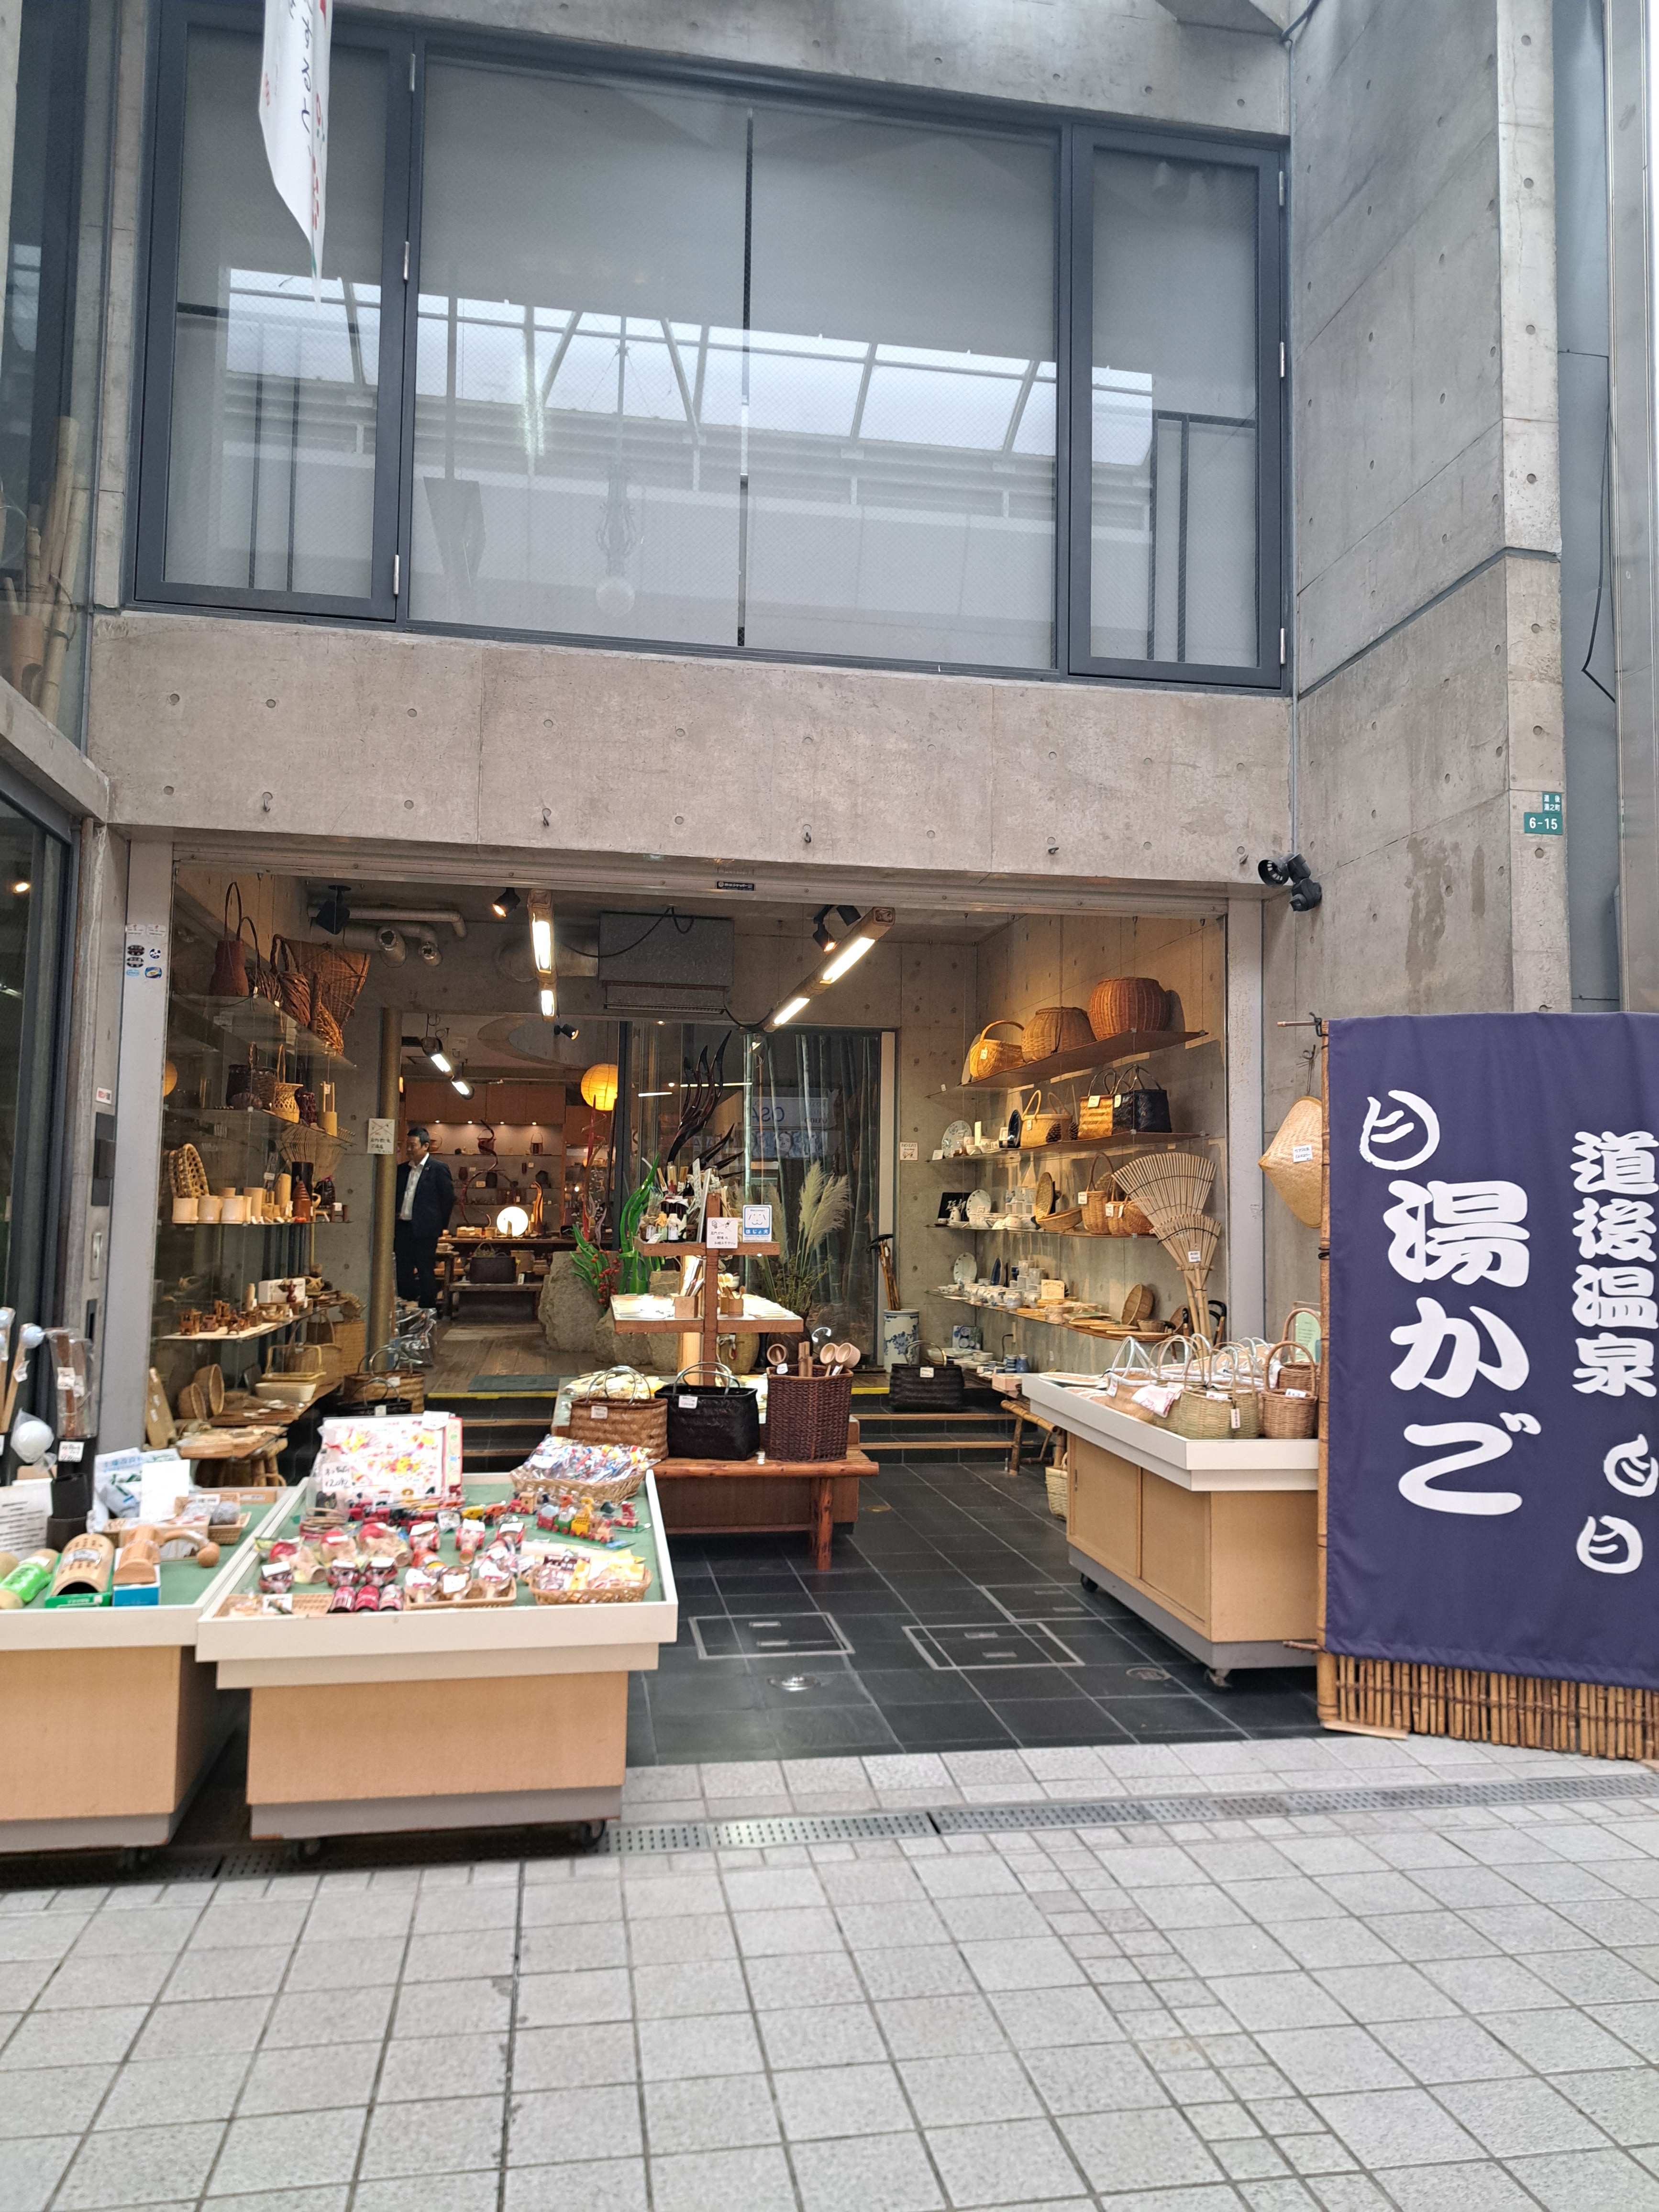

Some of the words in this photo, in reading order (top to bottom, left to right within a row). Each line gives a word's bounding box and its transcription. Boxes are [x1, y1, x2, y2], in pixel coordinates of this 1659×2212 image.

[1529, 817, 1558, 830] 6-15
[1383, 1180, 1542, 1515] 湯かご
[1570, 1131, 1659, 1397] 道後温泉
